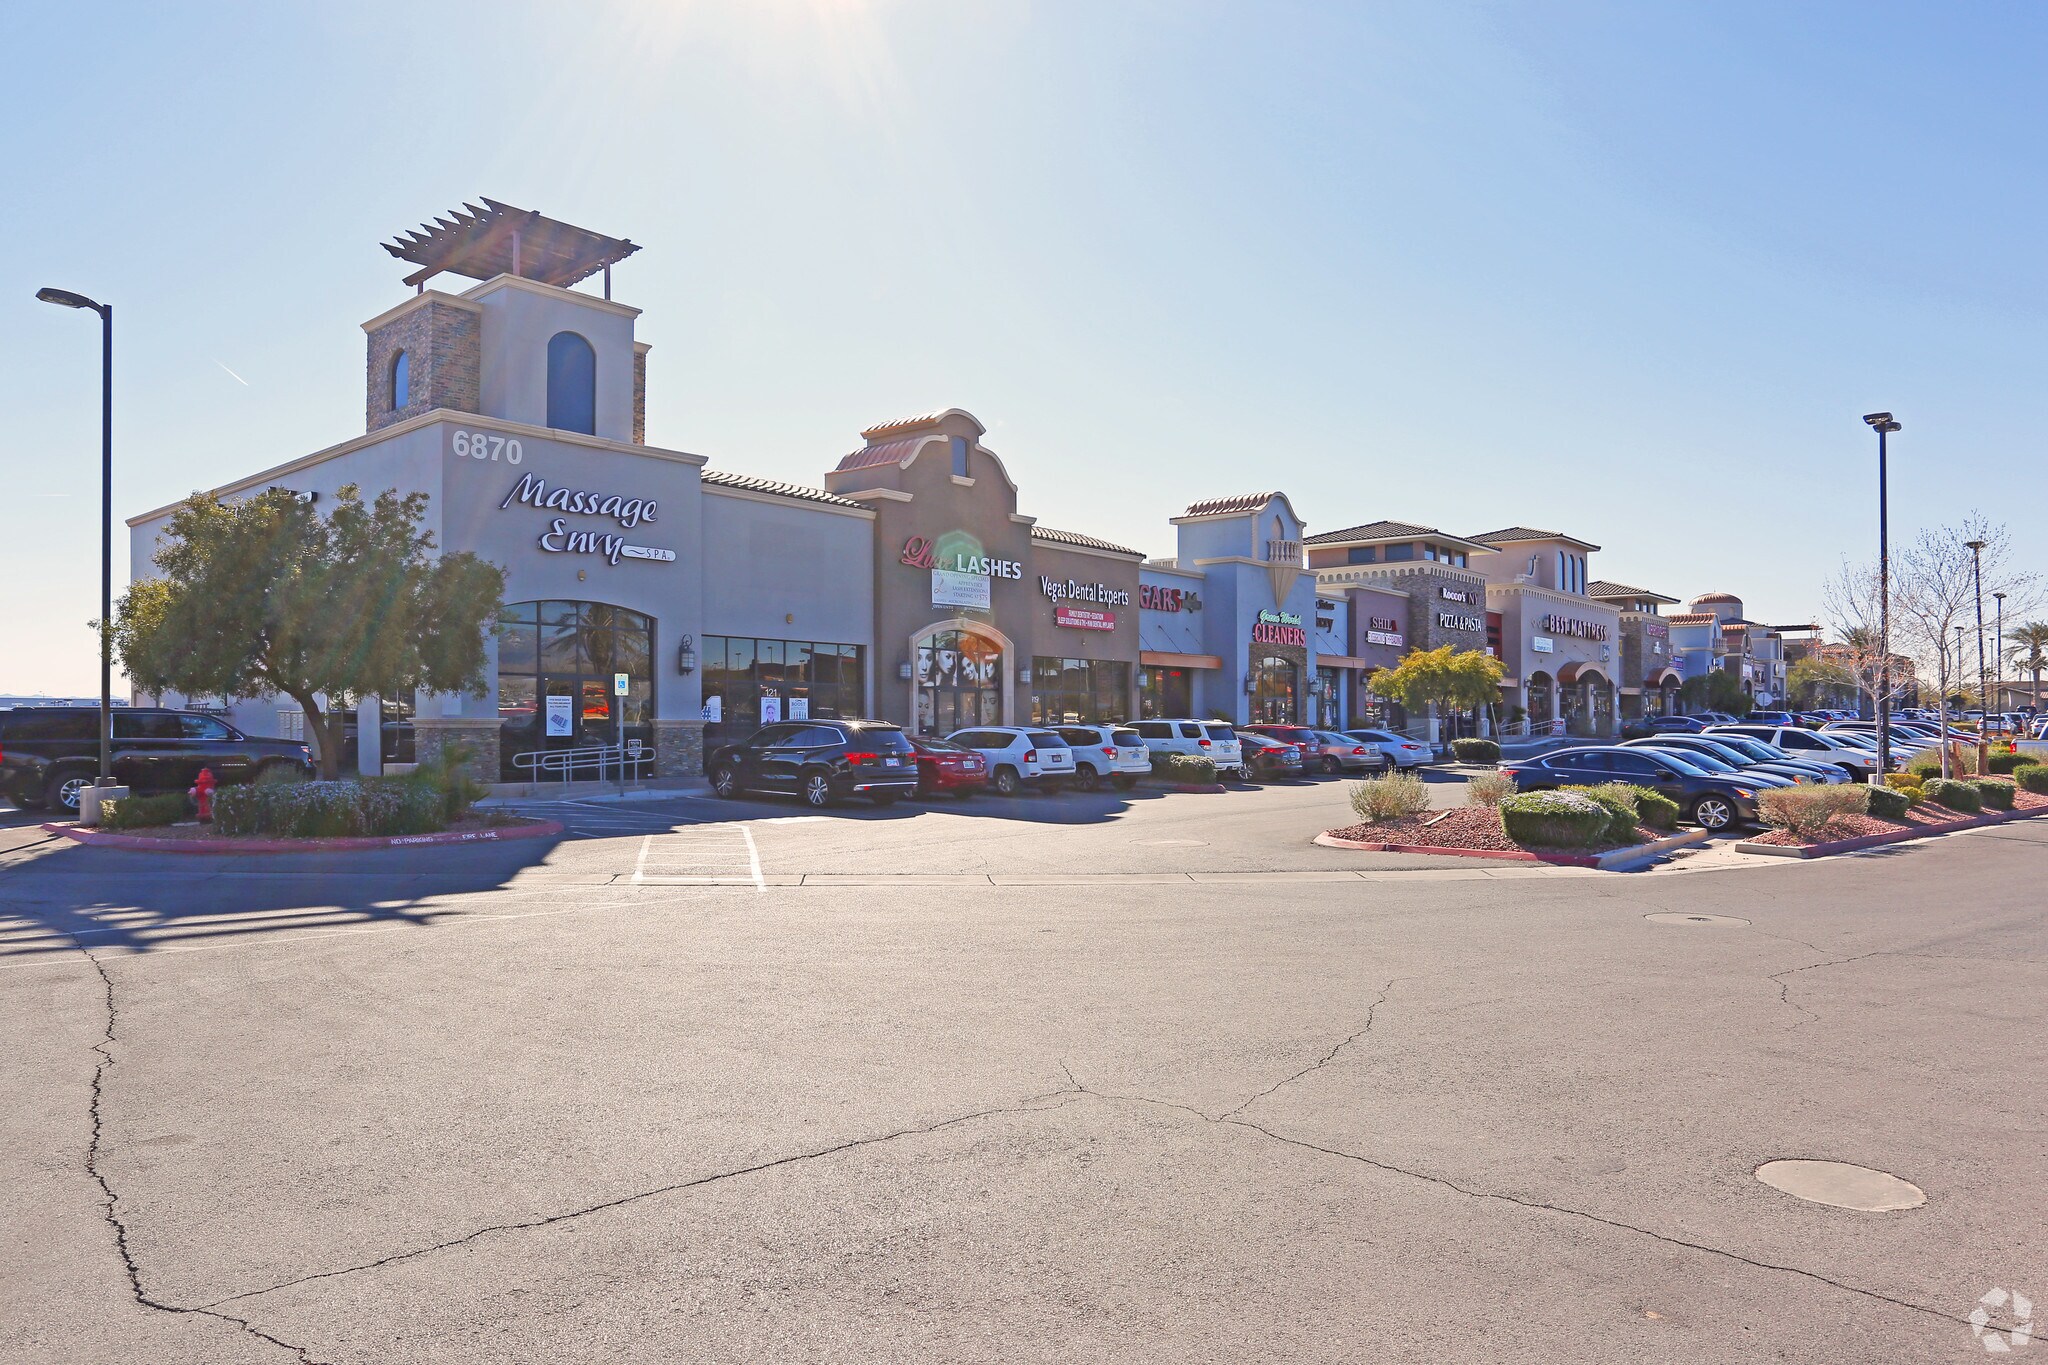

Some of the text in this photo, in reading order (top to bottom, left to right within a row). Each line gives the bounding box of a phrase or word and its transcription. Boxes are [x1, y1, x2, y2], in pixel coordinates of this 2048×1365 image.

[452, 430, 523, 464] 6870
[500, 472, 657, 528] Massage
[539, 518, 667, 566] Envy SPA
[957, 553, 1022, 580] LASHES
[1041, 575, 1129, 609] Vegas Dental Experts
[1442, 587, 1466, 603] Rocco's
[1255, 623, 1306, 647] CLEANERS
[1439, 612, 1482, 632] PIZZA & PASTA
[1549, 614, 1607, 641] BEST MATTRESS
[765, 688, 777, 697] 121
